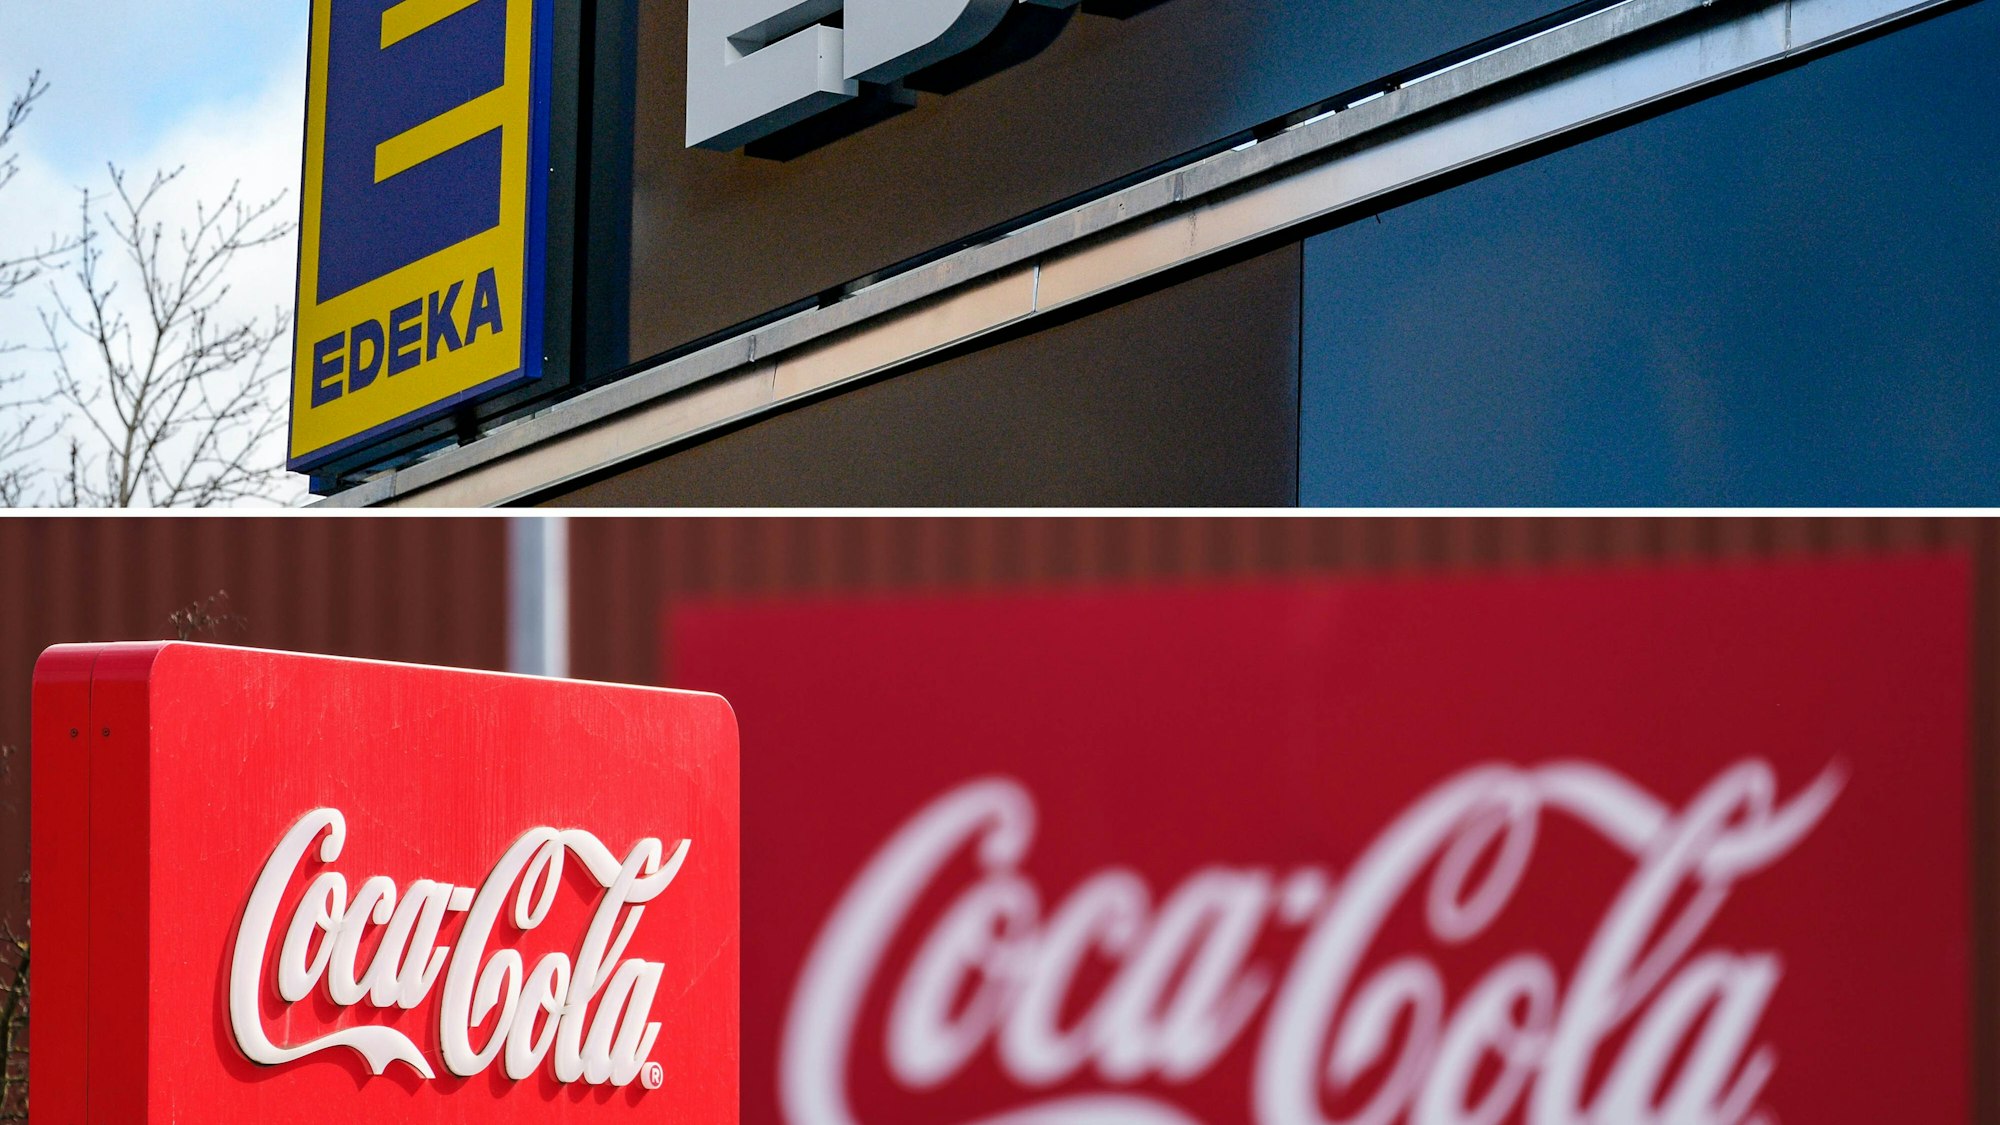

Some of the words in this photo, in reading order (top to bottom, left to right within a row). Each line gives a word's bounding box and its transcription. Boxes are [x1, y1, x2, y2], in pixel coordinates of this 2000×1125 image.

[311, 267, 503, 409] EDEKA
[229, 807, 692, 1087] Coca-Cola
[779, 757, 1850, 1125] Coca-Cola
